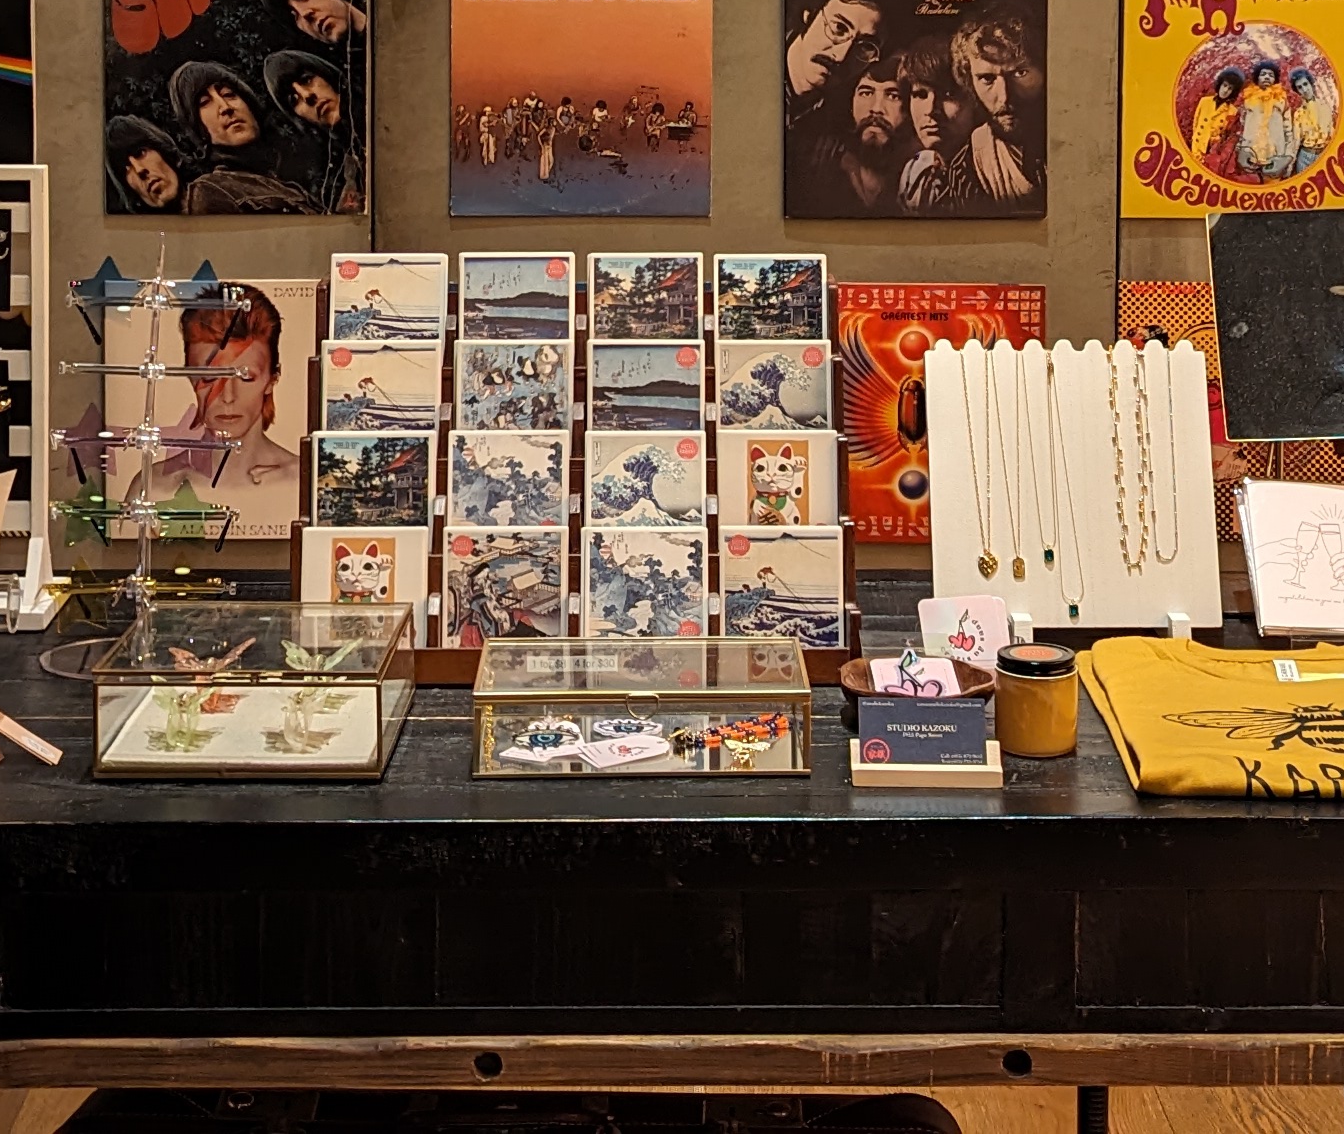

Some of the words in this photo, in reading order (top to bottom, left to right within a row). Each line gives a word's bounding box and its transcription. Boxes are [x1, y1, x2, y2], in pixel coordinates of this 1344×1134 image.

[273, 287, 314, 298] DAVID
[881, 312, 926, 321] GREATEST
[929, 312, 949, 321] HITS
[180, 524, 246, 536] ALADIN
[249, 524, 288, 536] SANE
[887, 724, 920, 732] STUDIO
[922, 724, 957, 732] KAZOKU
